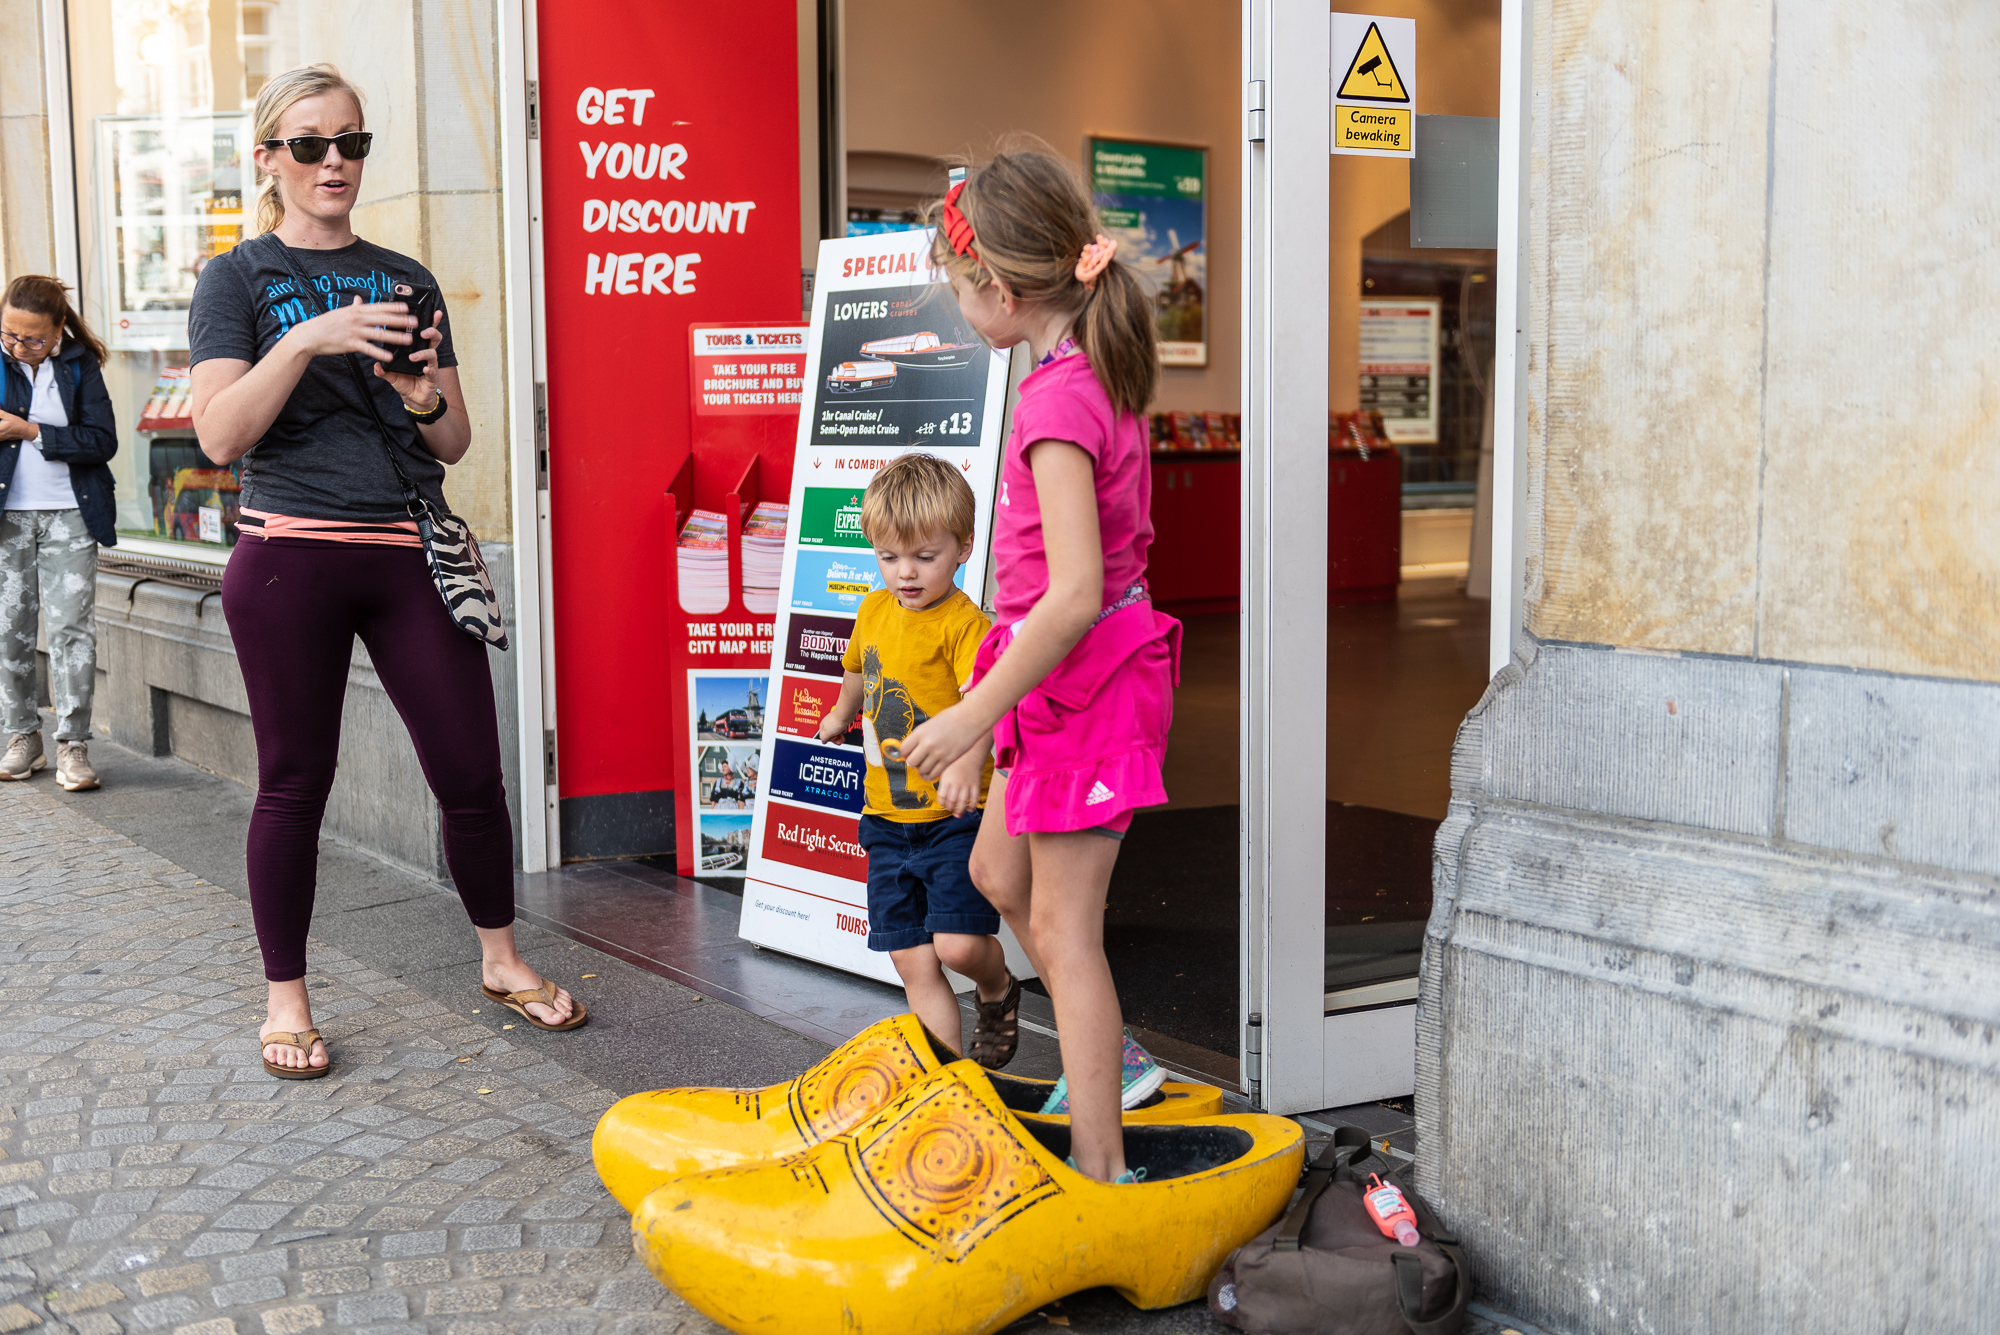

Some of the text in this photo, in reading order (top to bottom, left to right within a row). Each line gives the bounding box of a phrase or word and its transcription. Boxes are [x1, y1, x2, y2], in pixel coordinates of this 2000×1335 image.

[576, 86, 655, 126] GET
[1350, 110, 1396, 125] Camera
[1345, 127, 1401, 146] bewaking
[578, 141, 688, 180] YOUR
[582, 199, 757, 234] DISCOUNT
[842, 252, 917, 278] SPECIAL
[584, 252, 702, 295] HERE
[381, 271, 395, 293] li
[833, 300, 888, 321] LOVERS
[891, 299, 912, 308] canal
[889, 309, 918, 317] cruises
[705, 333, 802, 346] TOURS & TICKETS
[712, 363, 797, 376] TAKE YOUR FREE
[703, 378, 760, 391] BROCHURE
[762, 378, 784, 390] AND
[702, 393, 731, 405] YOUR
[733, 393, 775, 405] TICKETS
[822, 410, 834, 421] 1hr
[834, 410, 854, 421] Canal
[854, 410, 877, 421] Cruise
[820, 423, 899, 437] Semi-Open Boat Cruise
[834, 458, 846, 469] IN
[686, 623, 776, 637] TAKE YOUR FR
[688, 640, 774, 654] CITY MAP HER
[800, 633, 836, 652] BODY
[800, 649, 809, 658] The
[810, 651, 838, 661] Happiness
[792, 688, 823, 706] Madame
[792, 702, 821, 718] Tussauds
[809, 755, 852, 769] AMSTERDAM
[798, 763, 859, 790] ICEBAR
[804, 785, 850, 800] XTRACOLD
[777, 822, 867, 858] Red Light Secrets
[755, 899, 811, 921] Get your discount here!
[836, 912, 868, 937] TOURS
